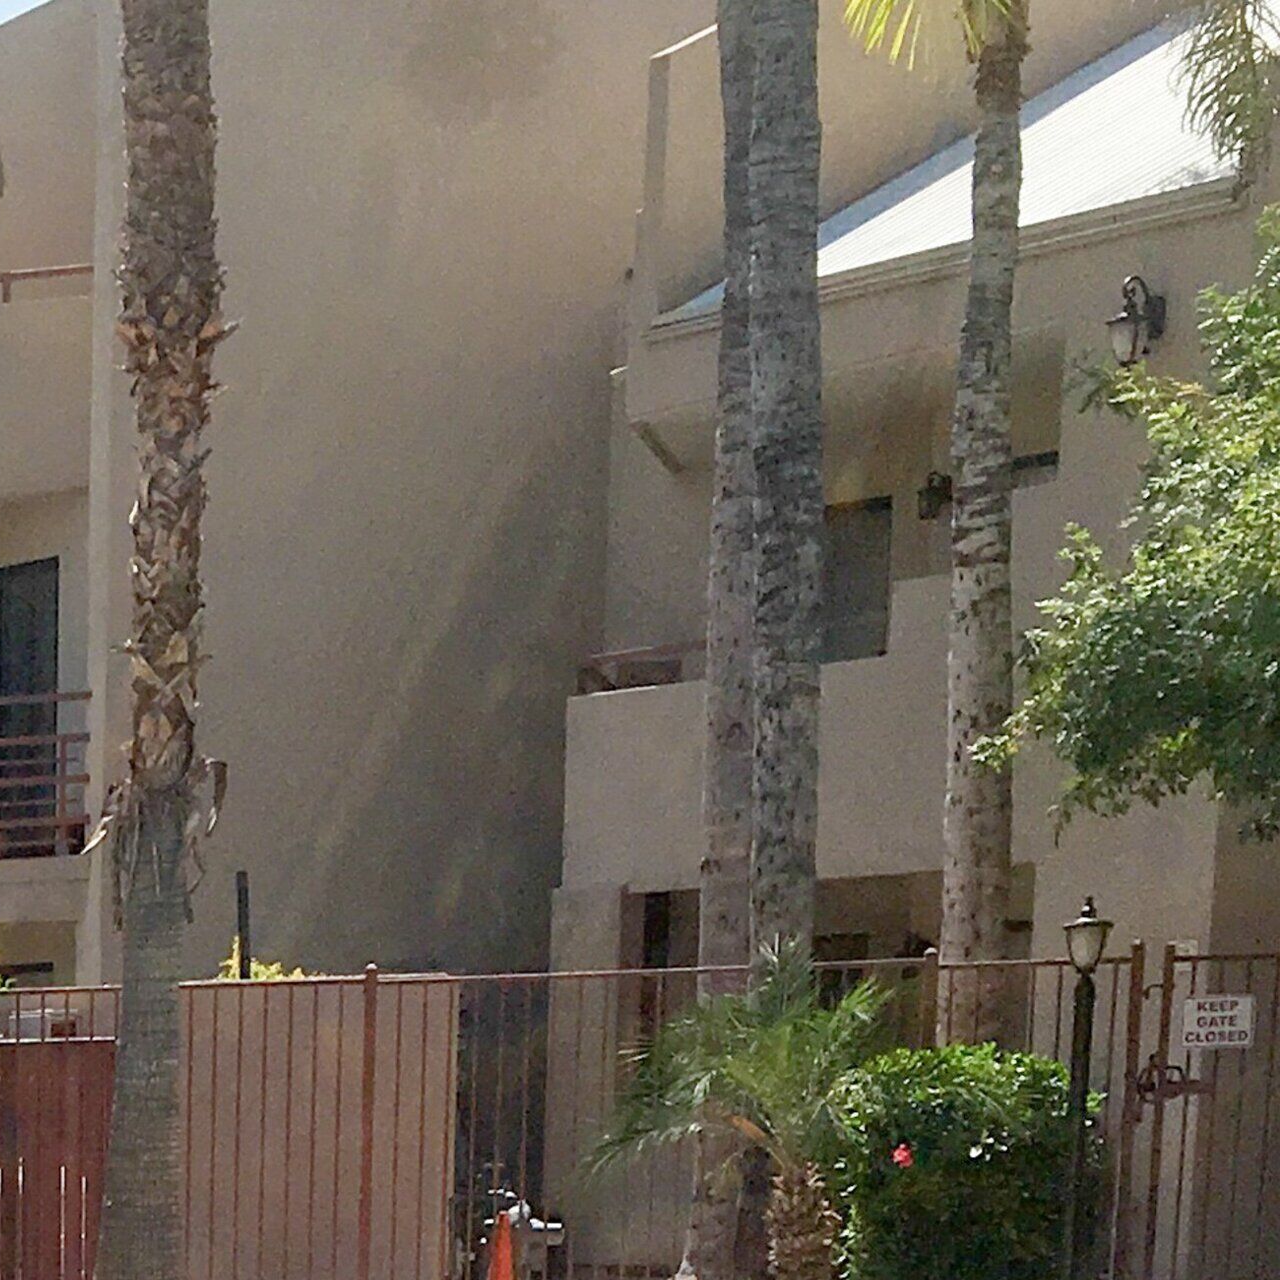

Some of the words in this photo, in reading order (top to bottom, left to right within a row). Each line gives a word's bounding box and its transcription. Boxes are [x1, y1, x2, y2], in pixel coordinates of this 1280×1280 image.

[1197, 1001, 1240, 1012] KEEP
[1196, 1016, 1238, 1028] GATE
[1185, 1030, 1248, 1043] CLOSED
